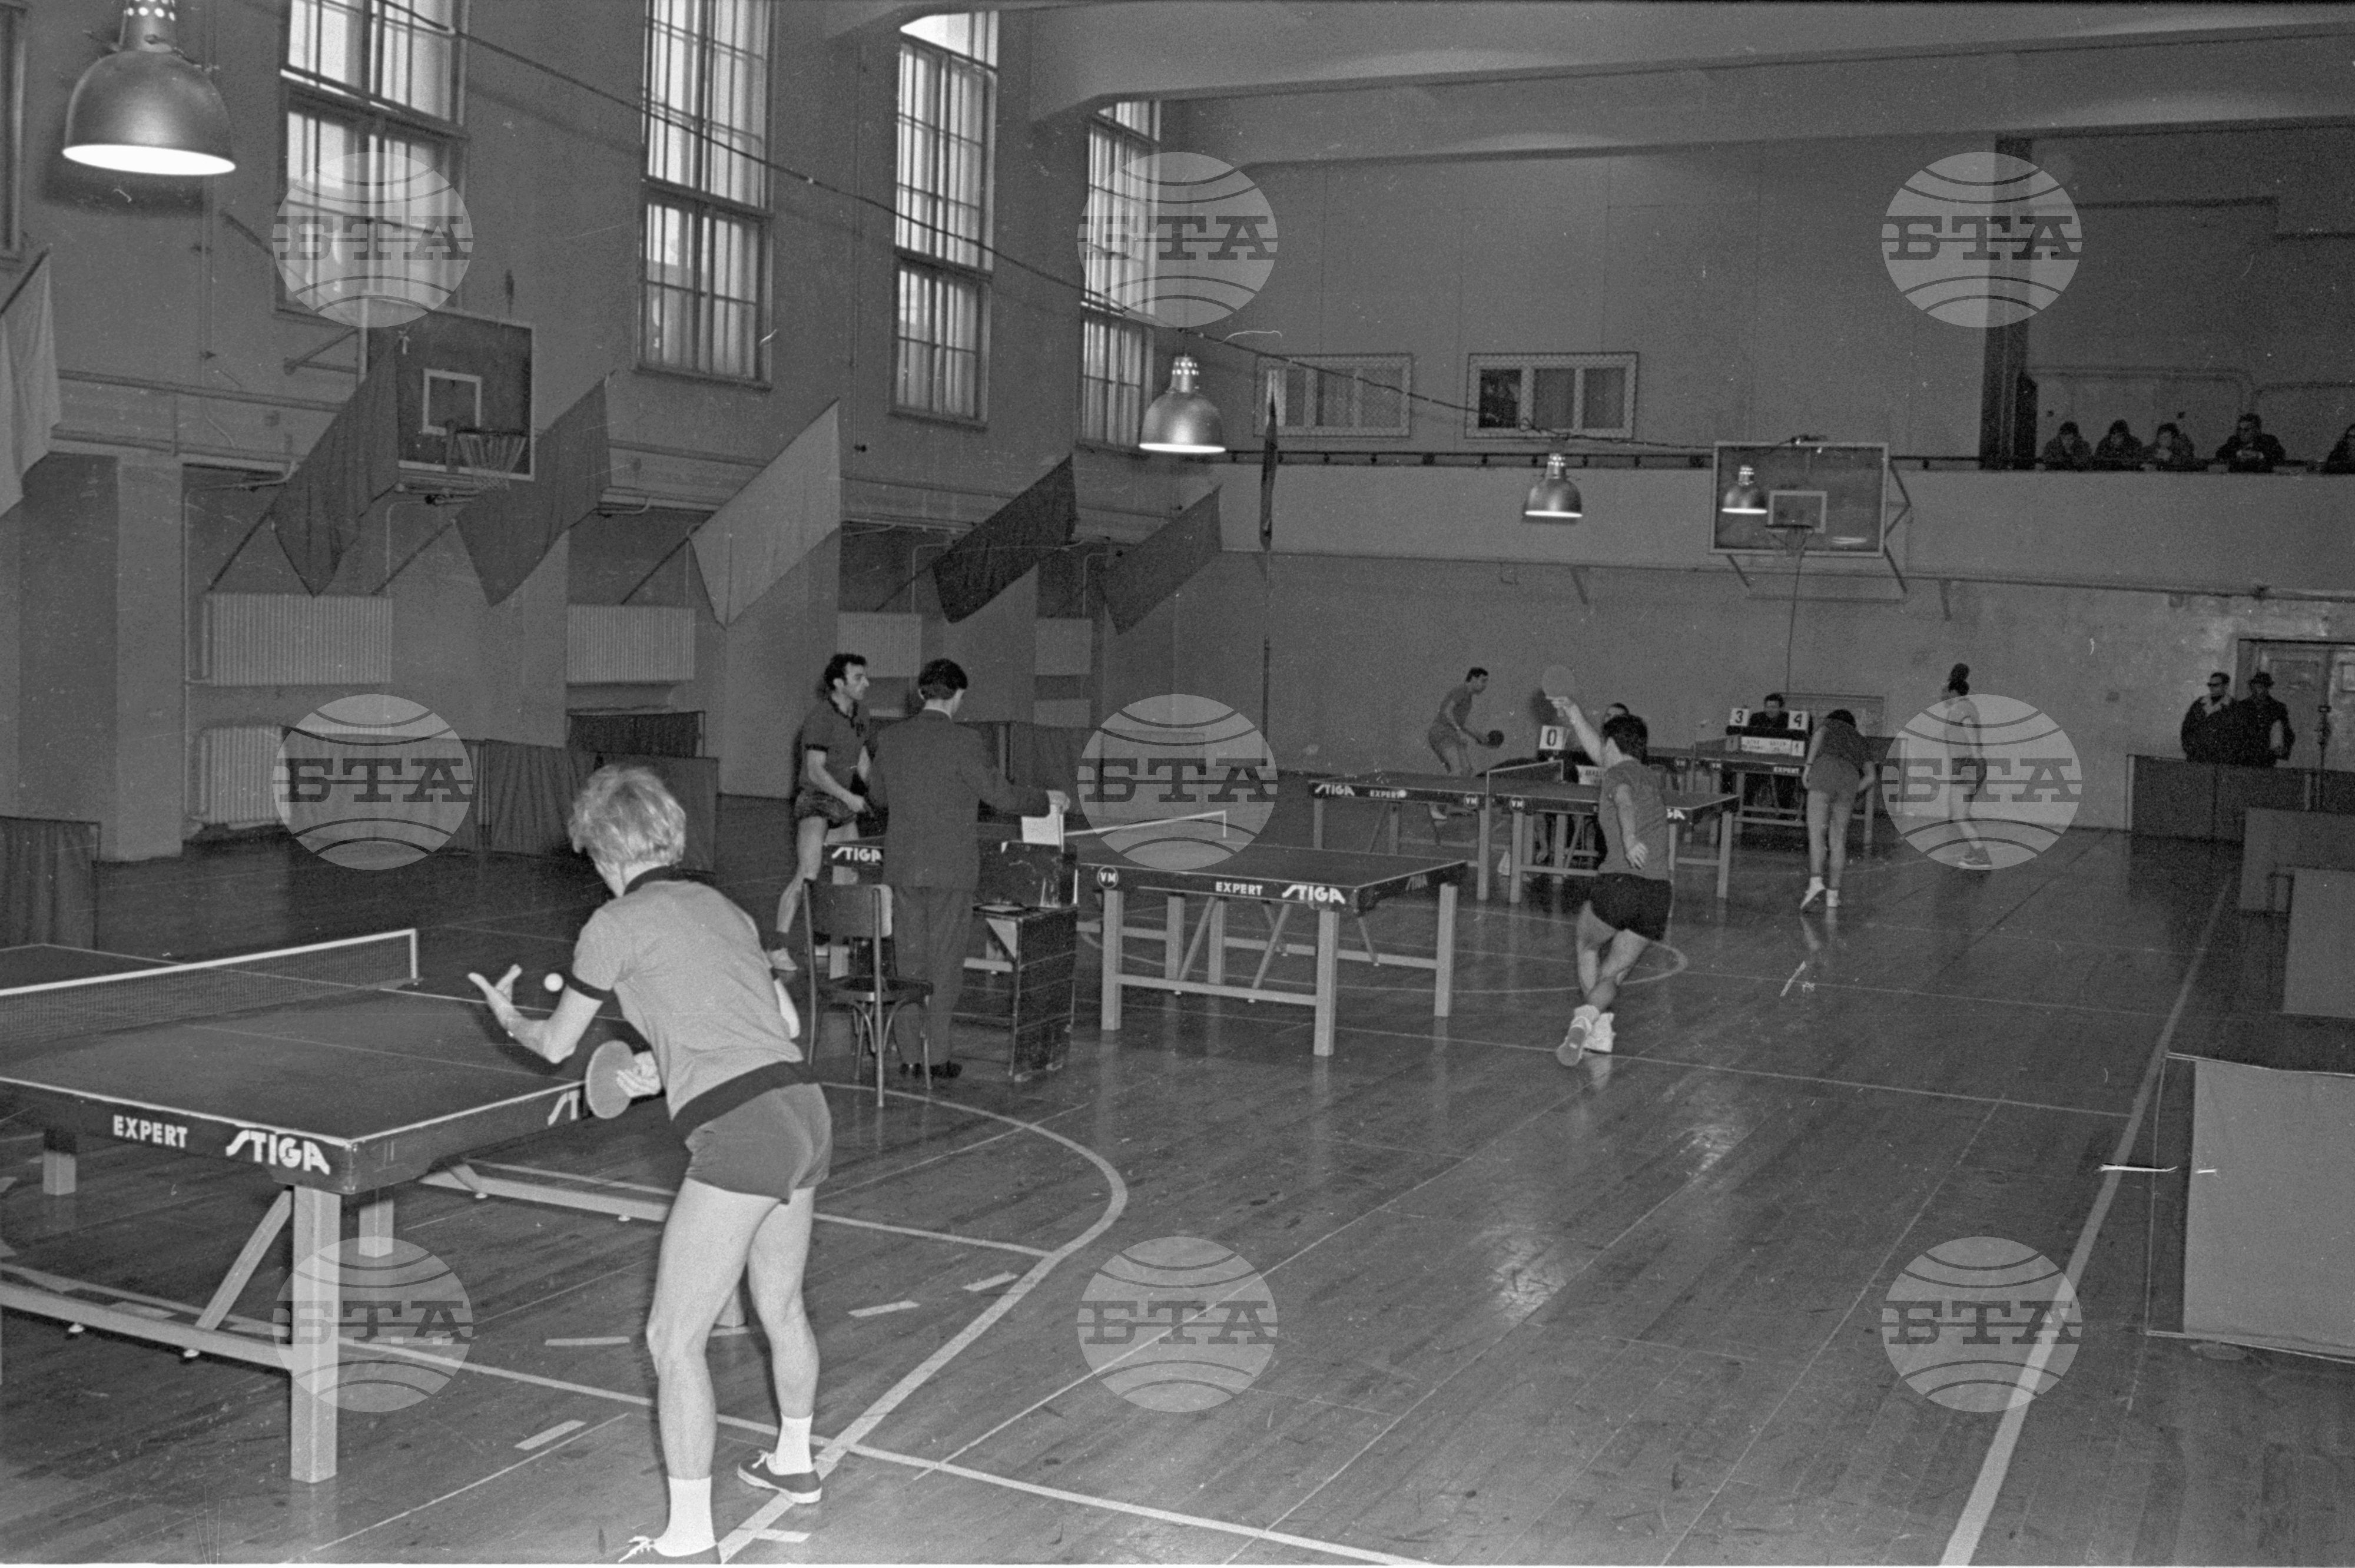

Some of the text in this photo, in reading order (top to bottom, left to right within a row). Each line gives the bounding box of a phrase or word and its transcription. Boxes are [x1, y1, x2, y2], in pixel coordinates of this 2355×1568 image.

[1735, 710, 1744, 724] 3
[1794, 713, 1803, 728] 4
[1547, 729, 1557, 747] 0
[1315, 784, 1355, 796] STIGA
[831, 847, 883, 862] STIGA
[1100, 872, 1116, 883] VM
[1215, 881, 1346, 904] EXPERT STIGA
[113, 1115, 330, 1175] EXPERT STIGA
